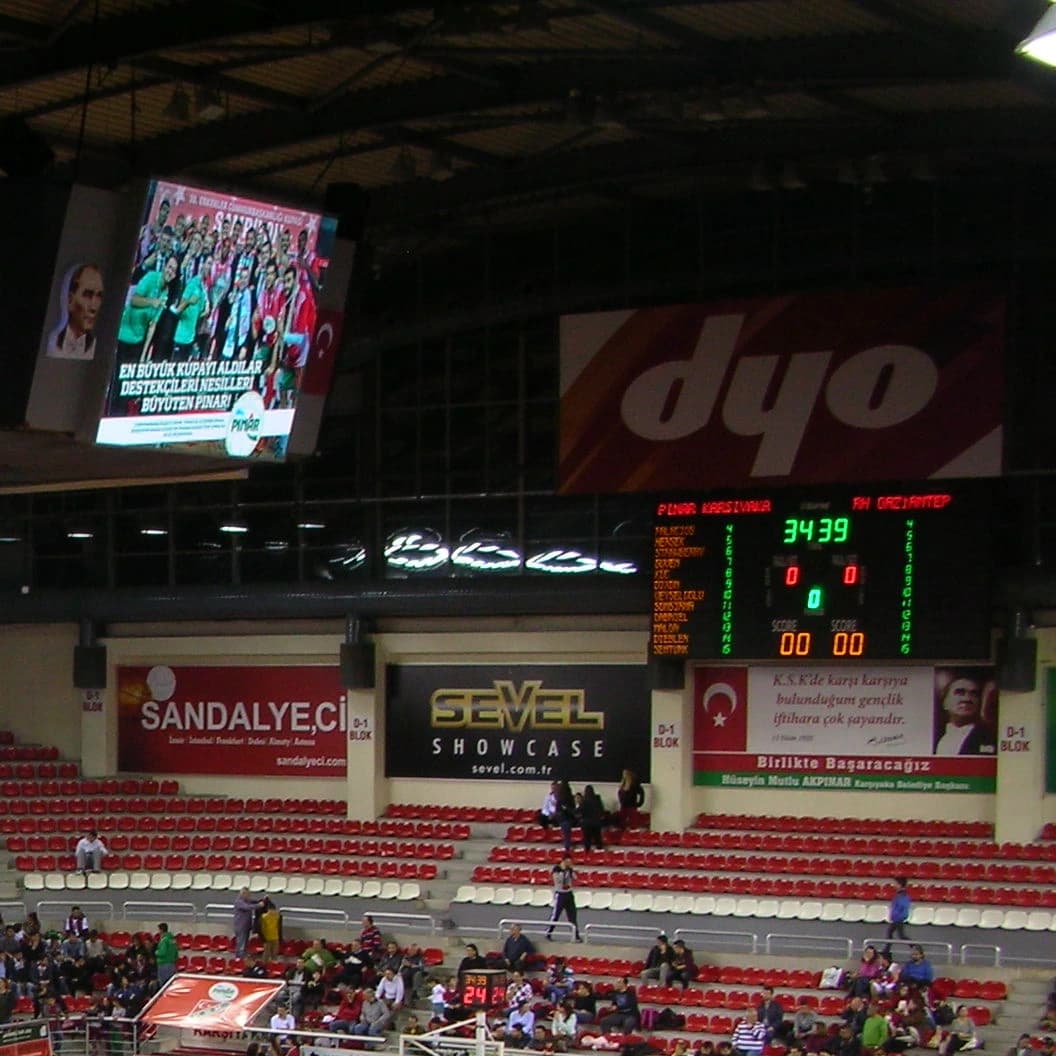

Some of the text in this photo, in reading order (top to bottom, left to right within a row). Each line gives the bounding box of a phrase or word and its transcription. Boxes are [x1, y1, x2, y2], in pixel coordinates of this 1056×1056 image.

[119, 360, 263, 379] EN BÜYÜK KUPAYI ALDILAR
[120, 375, 254, 397] DESTEKÇİLERİ NESİLLERİ
[621, 313, 938, 477] dyo
[141, 396, 195, 413] BÜYÜTEN
[231, 416, 260, 432] PINAR
[786, 566, 799, 585] 0
[844, 566, 857, 584] 0
[807, 588, 821, 608] 0
[780, 632, 811, 655] 00
[833, 632, 864, 655] 00
[828, 673, 859, 688] karşı
[862, 673, 909, 688] karşıya
[430, 680, 605, 732] SEVEL
[776, 693, 904, 709] bulunduğum gençlik
[353, 718, 369, 729] D-1
[773, 712, 820, 728] iftihara
[823, 713, 844, 727] çok
[349, 730, 372, 741] BLOK
[658, 724, 675, 735] D-1
[1006, 726, 1026, 739] D-1
[432, 738, 605, 758] SHOWCASE
[653, 737, 679, 748] BLOK
[1000, 740, 1030, 752] BLOK
[276, 755, 347, 769] sandalyeci.com
[471, 763, 553, 776] sevel.com.tr
[757, 756, 931, 773] Birlikte Başaracağız
[722, 774, 766, 787] Hüseyin
[802, 775, 853, 787] AKPINAR
[463, 986, 487, 1004] 24
